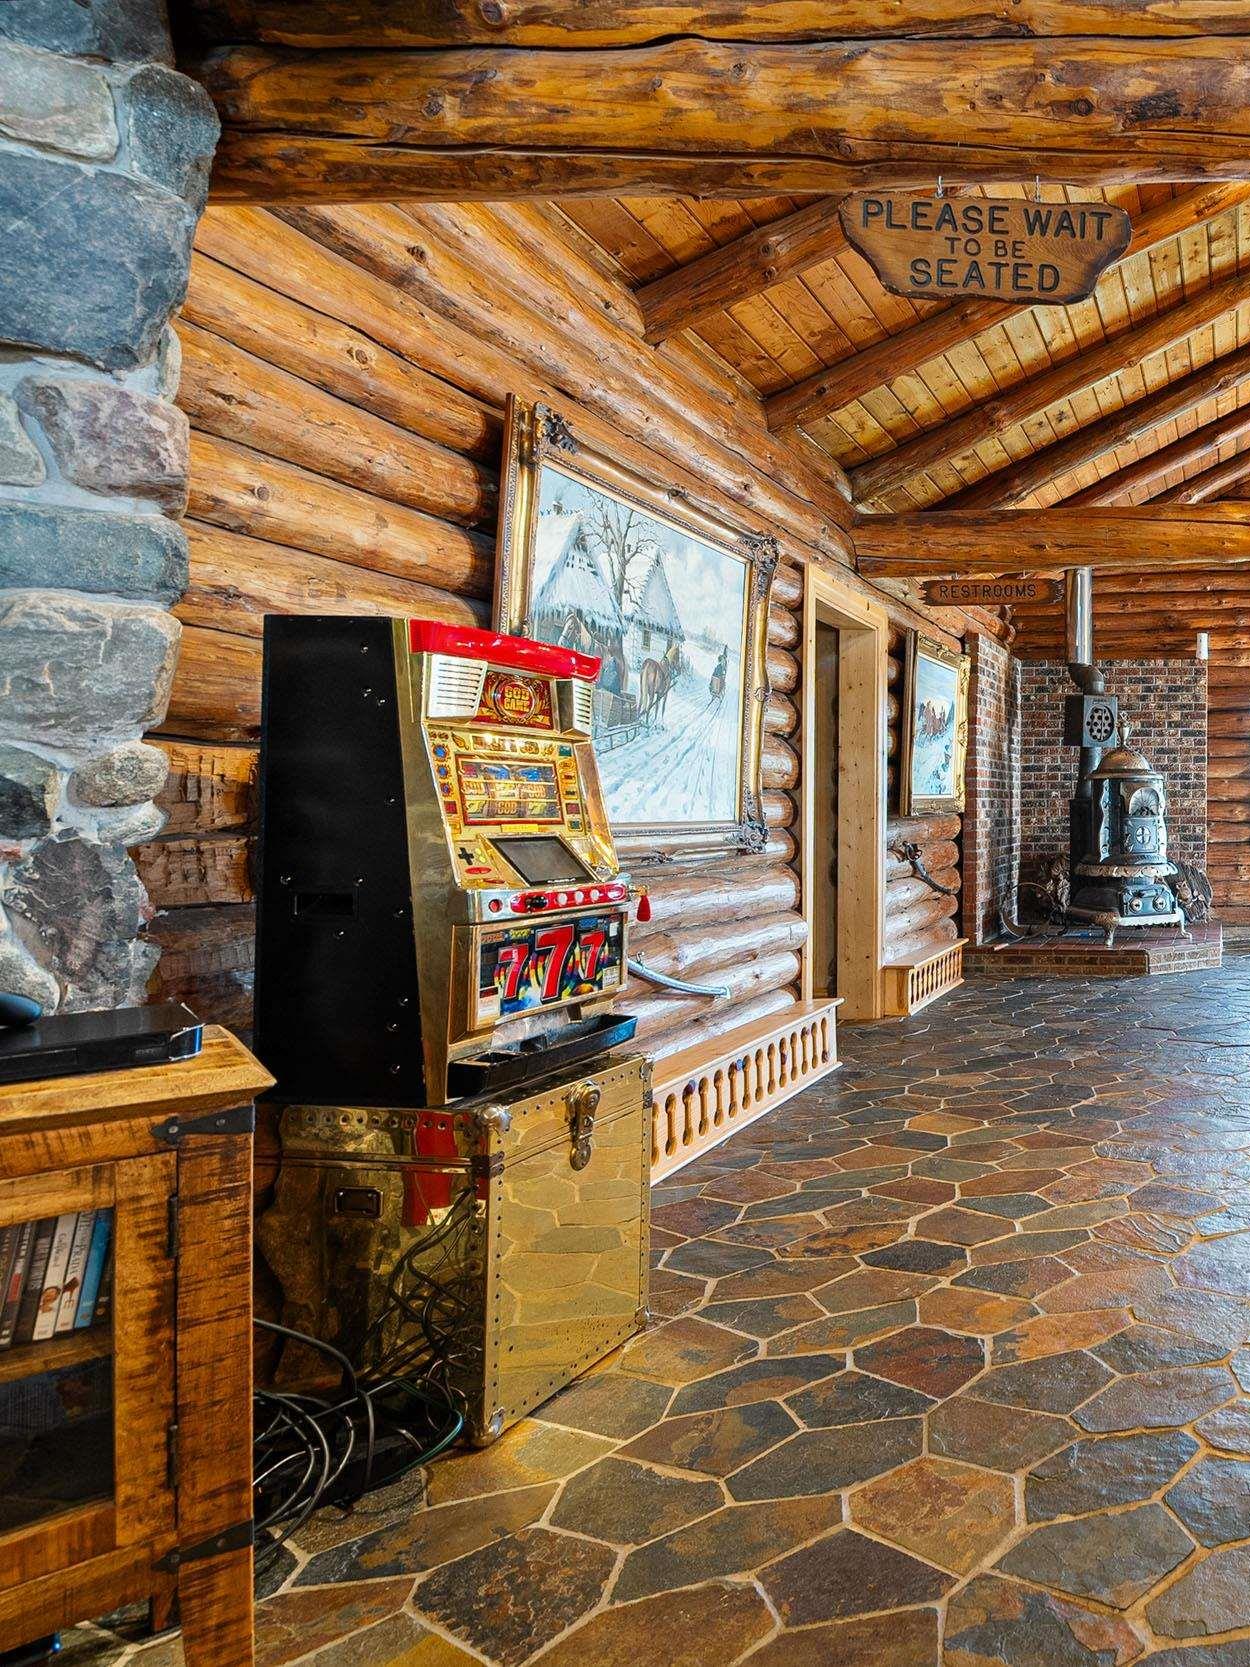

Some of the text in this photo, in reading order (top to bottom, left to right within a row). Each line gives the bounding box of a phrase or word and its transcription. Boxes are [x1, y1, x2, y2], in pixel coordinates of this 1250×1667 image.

[862, 199, 1112, 241] PLEASE WAIT
[945, 236, 1026, 259] TO BE
[910, 258, 1061, 292] SEATED
[940, 584, 1036, 599] RESTROOMS
